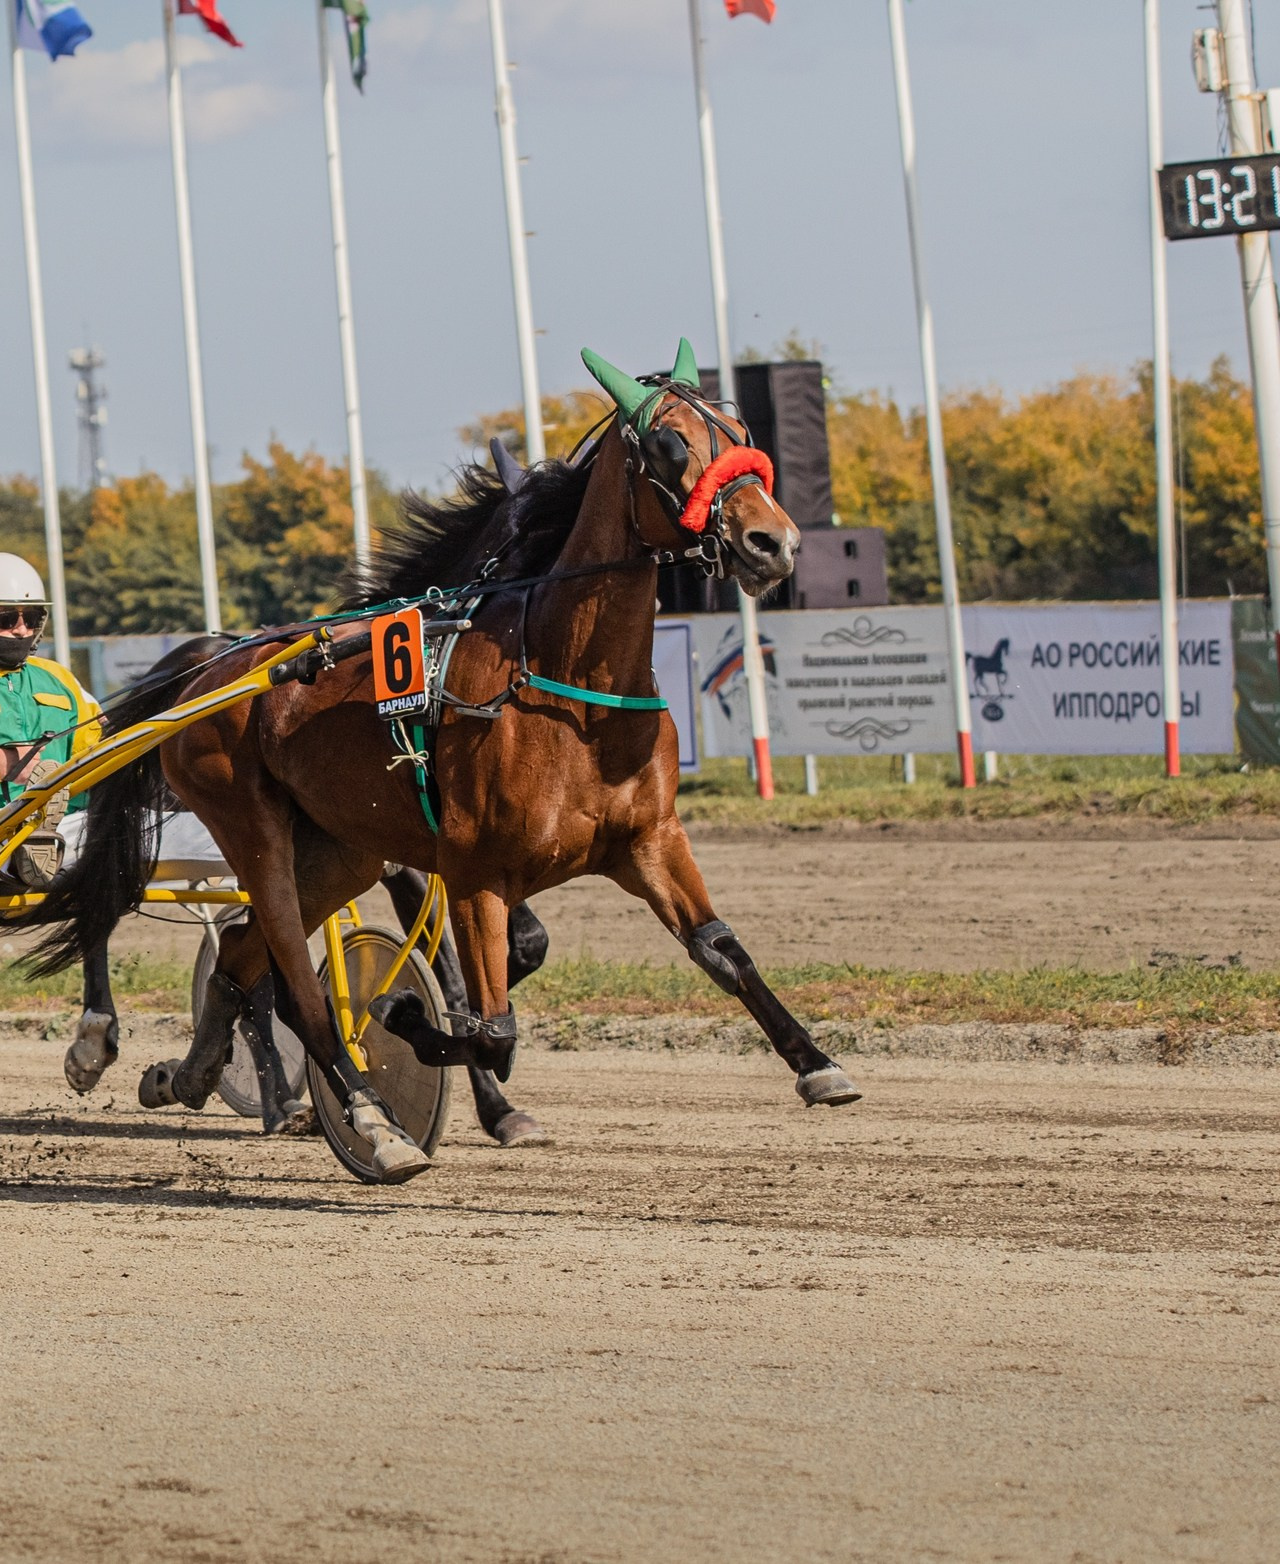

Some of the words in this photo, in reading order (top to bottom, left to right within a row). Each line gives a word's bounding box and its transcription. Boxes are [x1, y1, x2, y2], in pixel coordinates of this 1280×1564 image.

[1185, 165, 1280, 229] 13:21
[383, 621, 412, 694] 6
[1031, 642, 1062, 668] АО
[1069, 634, 1221, 668] РОССИЙКИЕ
[378, 693, 425, 715] БАРНАУЛ
[1053, 691, 1201, 723] ИППОДРОЫ
